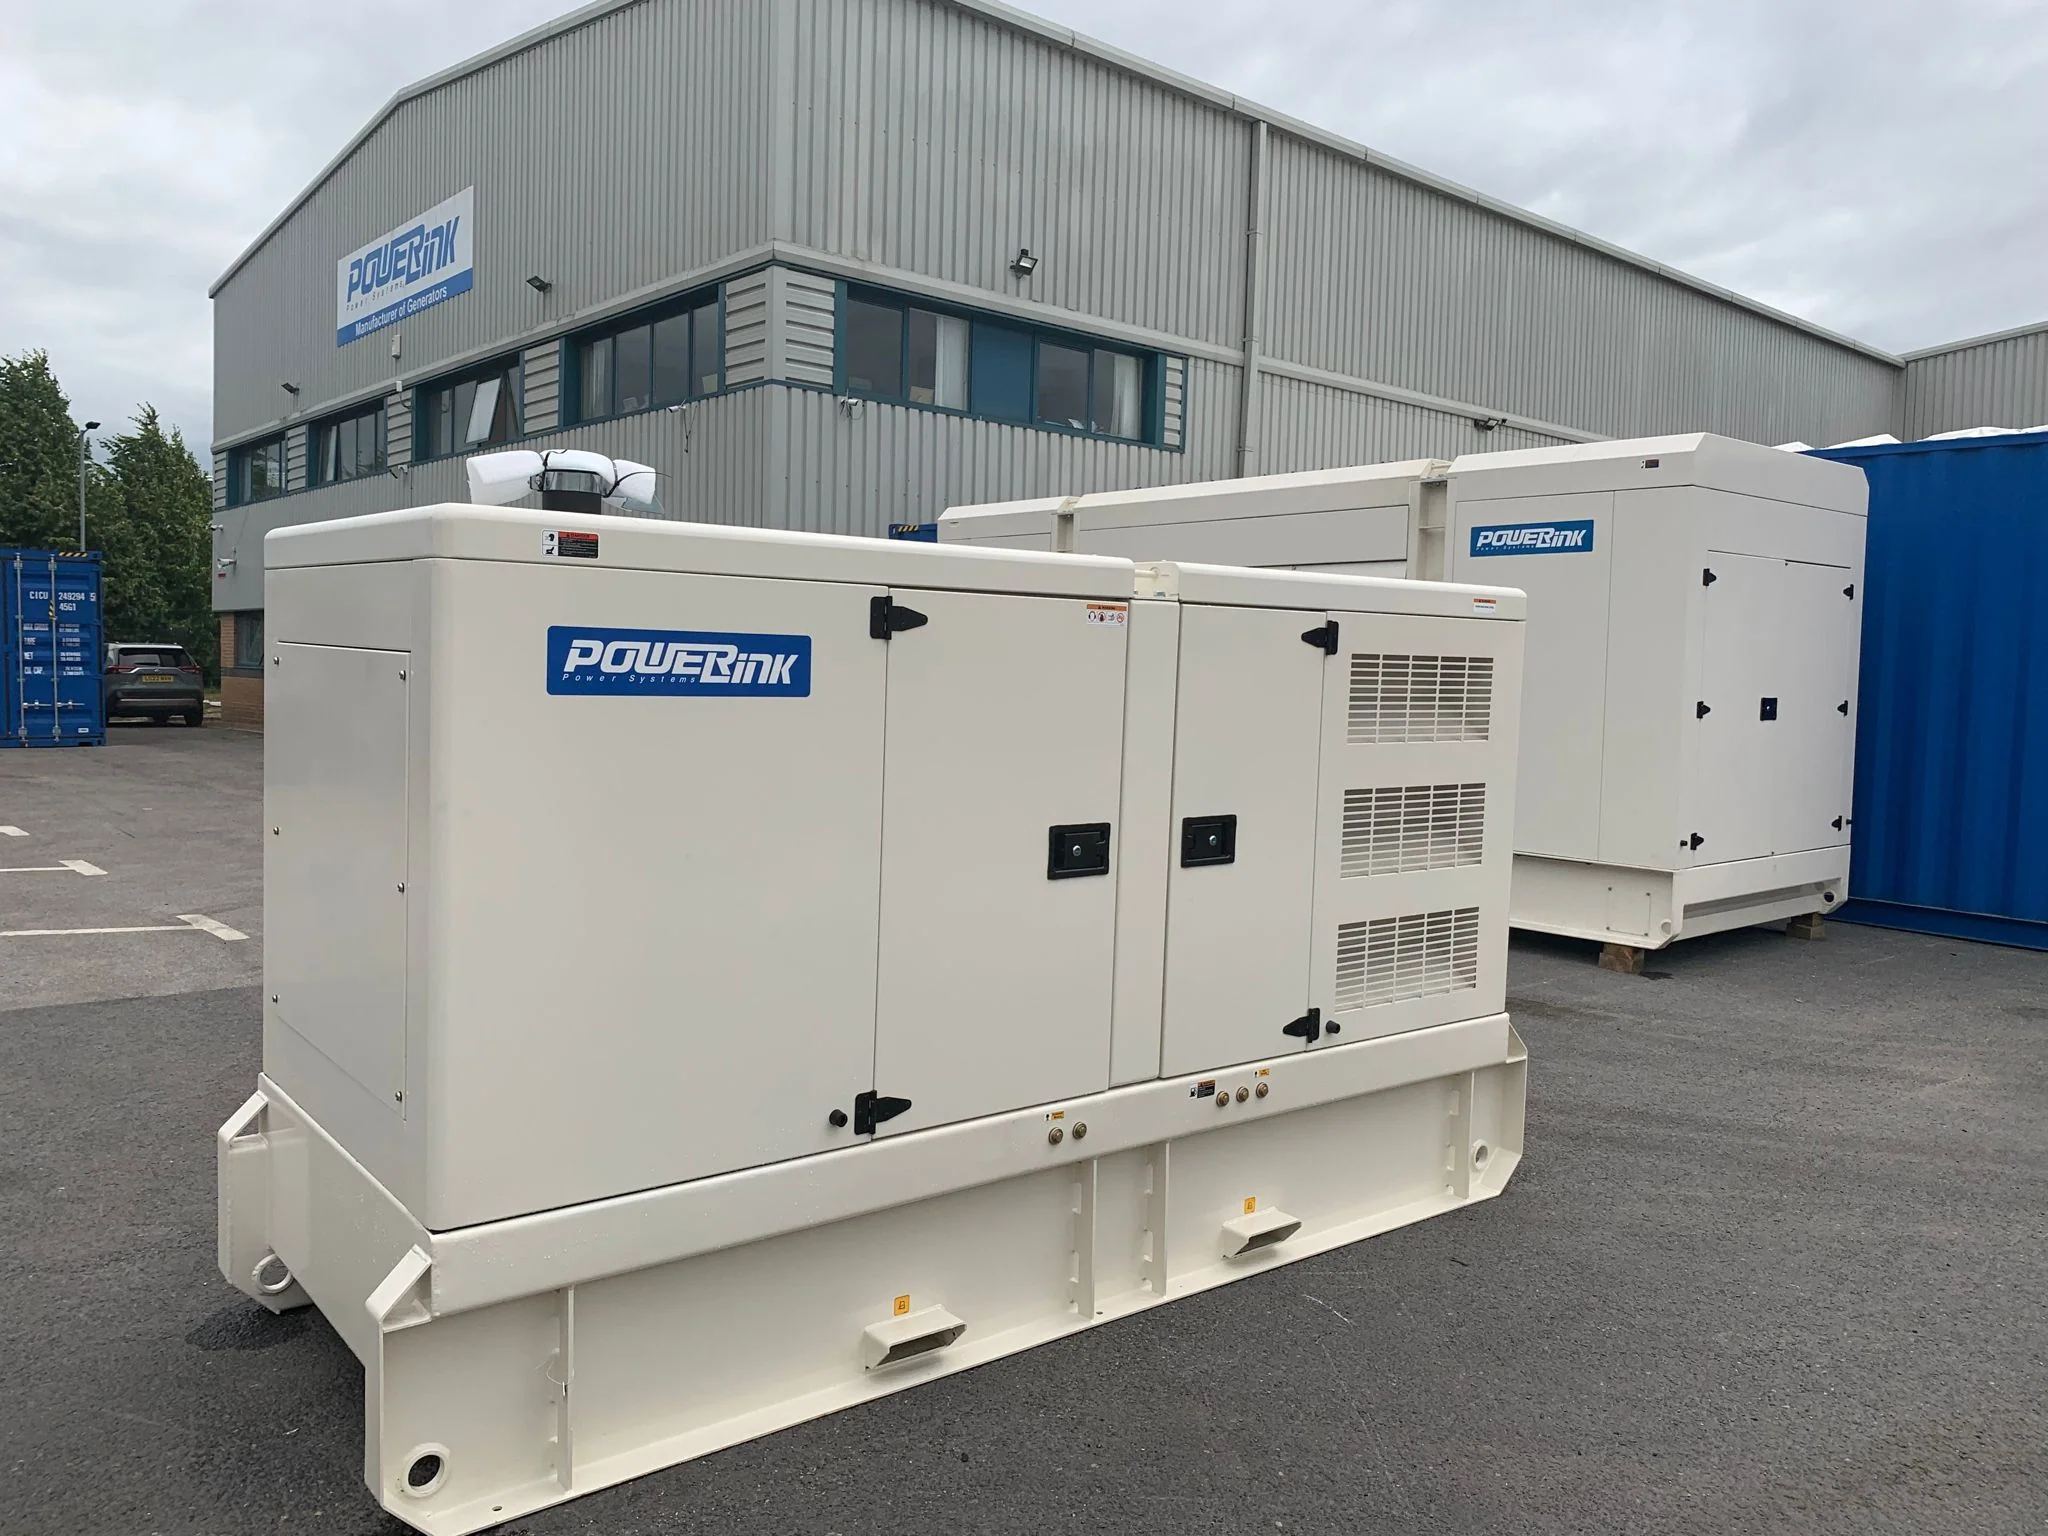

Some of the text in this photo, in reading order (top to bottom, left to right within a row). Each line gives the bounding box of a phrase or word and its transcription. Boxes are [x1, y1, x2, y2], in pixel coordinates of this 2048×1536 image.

[355, 286, 447, 336] Manufacturer of Generators
[562, 673, 696, 685] Power Systems
